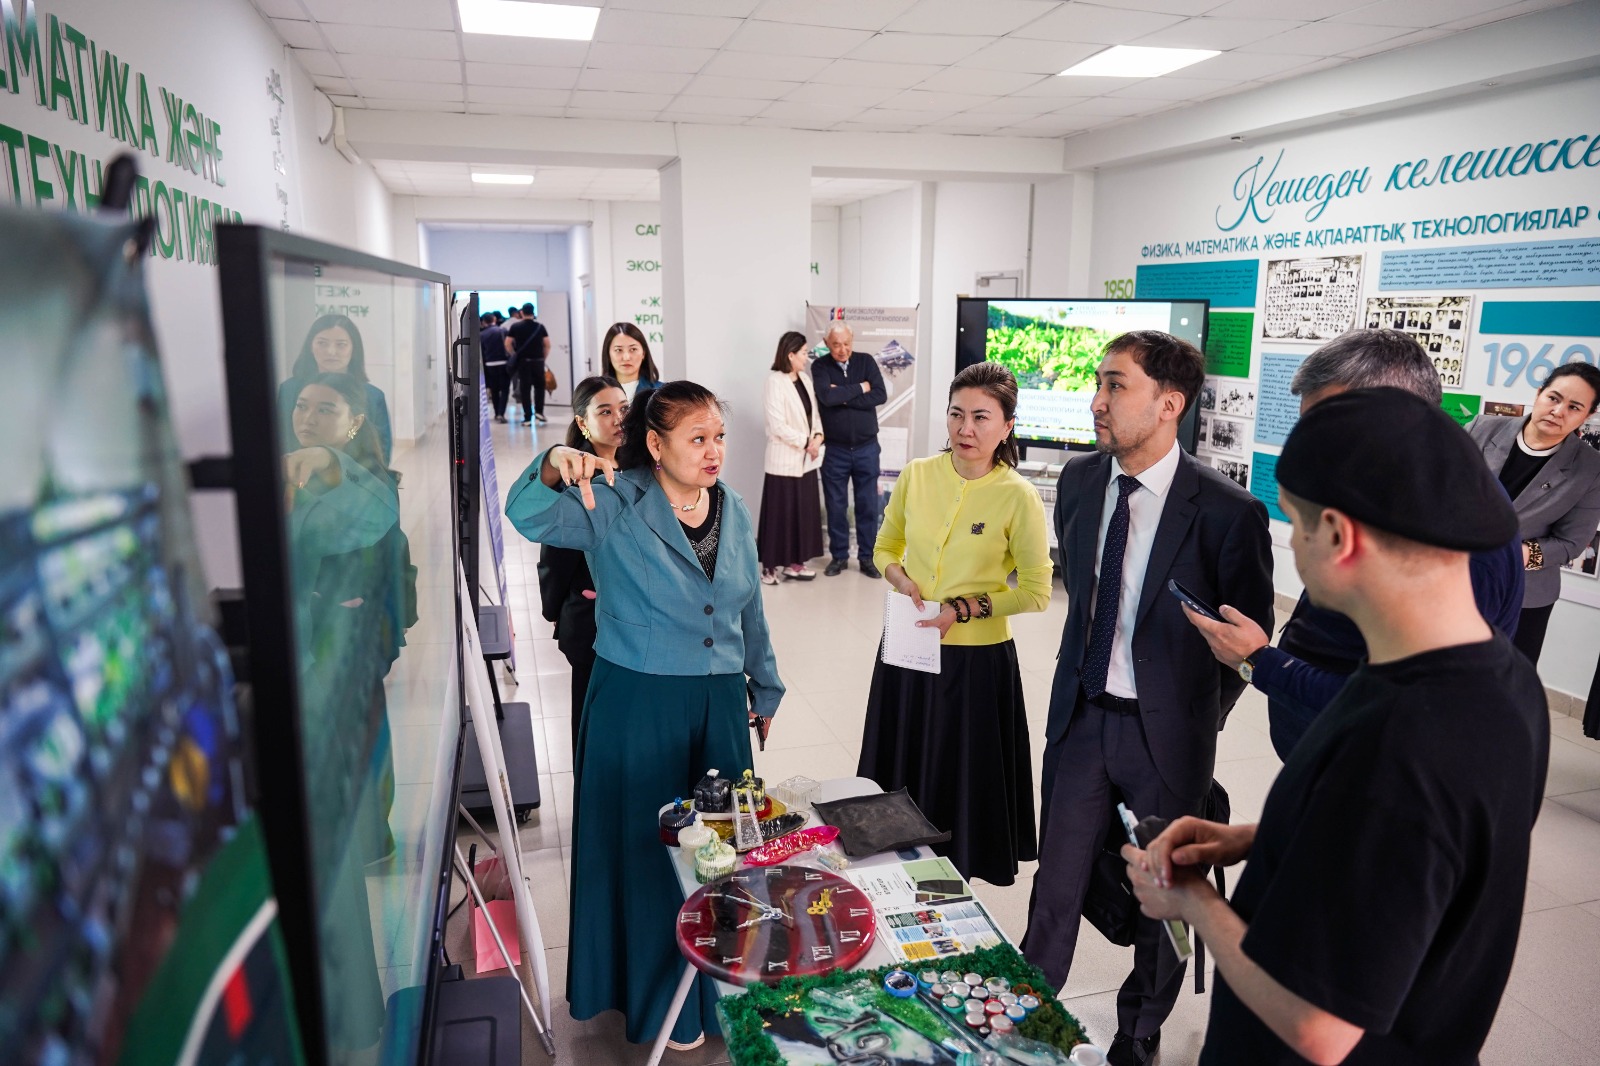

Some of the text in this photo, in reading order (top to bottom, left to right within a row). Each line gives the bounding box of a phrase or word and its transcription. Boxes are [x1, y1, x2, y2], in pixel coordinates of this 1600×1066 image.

[0, 0, 159, 157] МАТИКА
[159, 87, 226, 187] ЖӘНЕ
[1215, 148, 1371, 232] Кешеден
[1141, 243, 1182, 259] ФИЗИКА,
[1185, 236, 1259, 256] МАТЕМАТИКА
[1263, 231, 1301, 250] ЖӘНЕ
[1305, 222, 1406, 248] АҚПАРАТТЫҚ
[1412, 205, 1589, 239] ТЕХНОЛОГИЯЛАР
[1104, 278, 1133, 299] 1950
